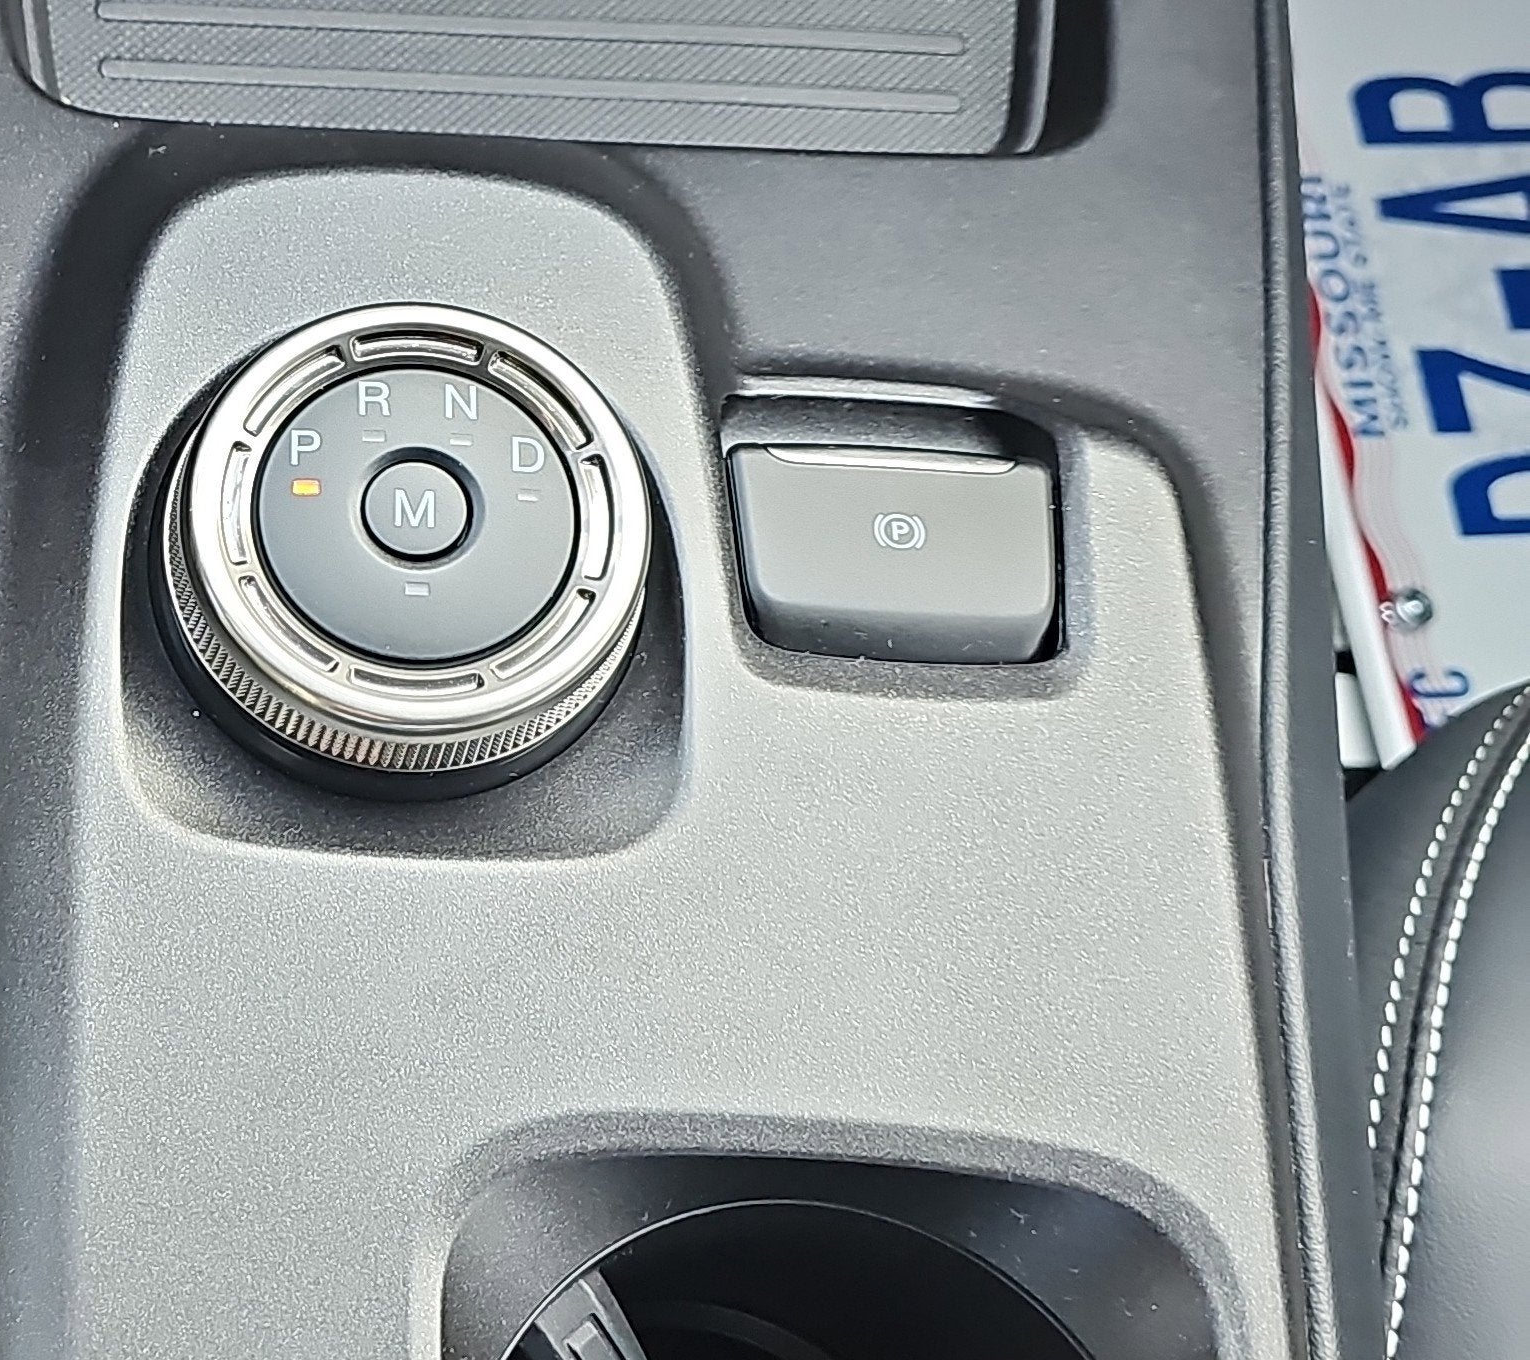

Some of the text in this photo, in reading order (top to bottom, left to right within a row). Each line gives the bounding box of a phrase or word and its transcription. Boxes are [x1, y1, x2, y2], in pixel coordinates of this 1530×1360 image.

[1299, 176, 1386, 438] MISSOURI
[357, 380, 391, 416] R
[444, 383, 478, 420] N
[289, 429, 322, 467] P
[510, 435, 545, 473] D
[393, 488, 436, 528] M
